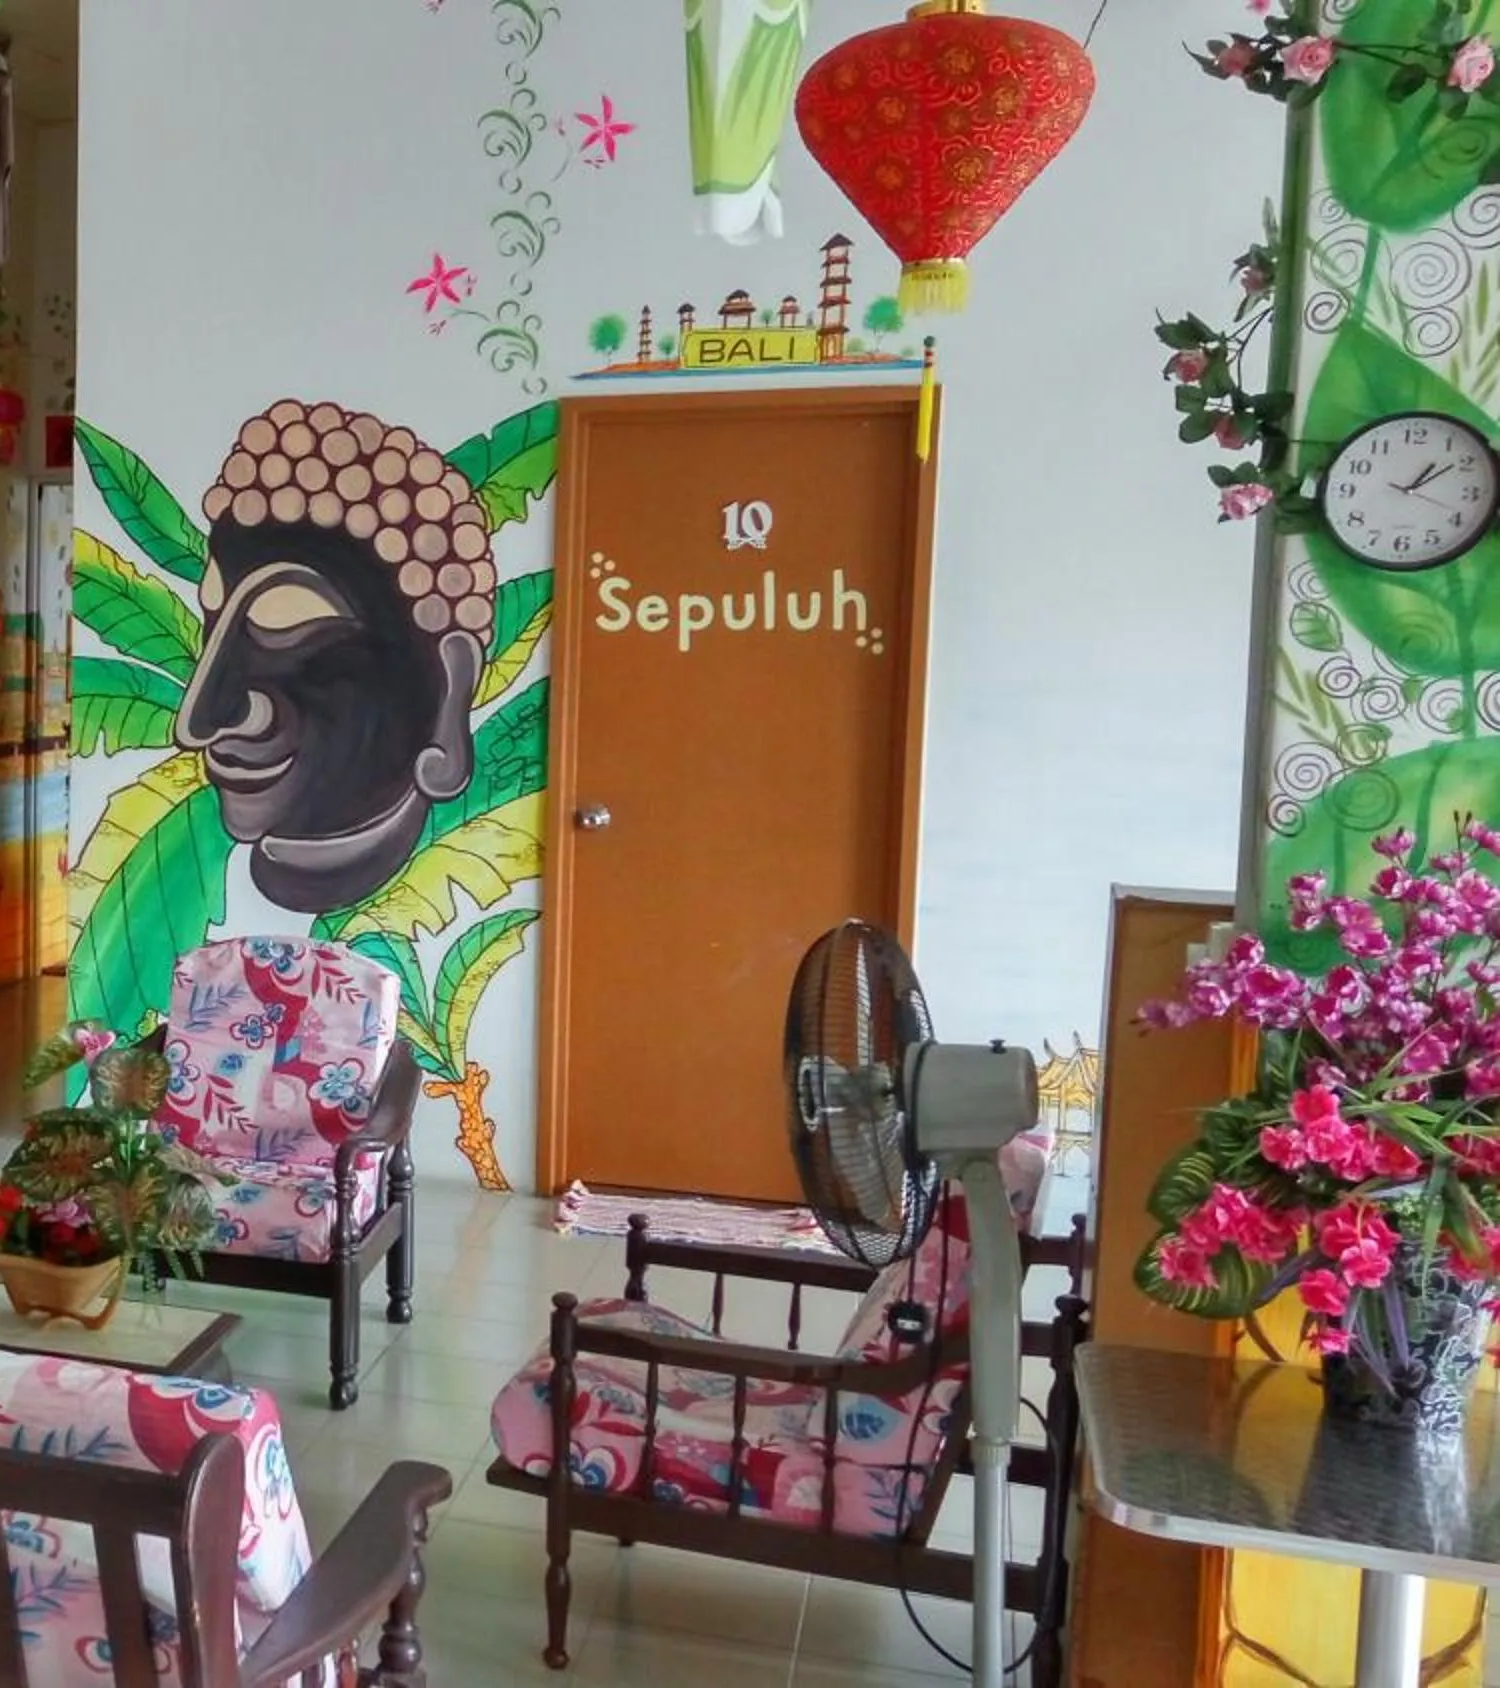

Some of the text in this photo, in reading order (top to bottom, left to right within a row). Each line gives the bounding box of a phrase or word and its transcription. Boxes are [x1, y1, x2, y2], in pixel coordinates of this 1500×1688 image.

[698, 336, 796, 364] BALI
[1404, 428, 1428, 445] 12
[1370, 439, 1389, 455] 11
[1349, 459, 1372, 475] 10
[1458, 455, 1475, 472] 2
[1339, 483, 1356, 498] 9
[1461, 485, 1480, 502] 3
[722, 500, 773, 545] 10
[1347, 511, 1365, 527] 8
[1448, 511, 1462, 527] 4
[1368, 529, 1382, 546] 7
[1393, 535, 1411, 552] 6
[1424, 529, 1441, 545] 5
[595, 568, 867, 652] Sepuluh
